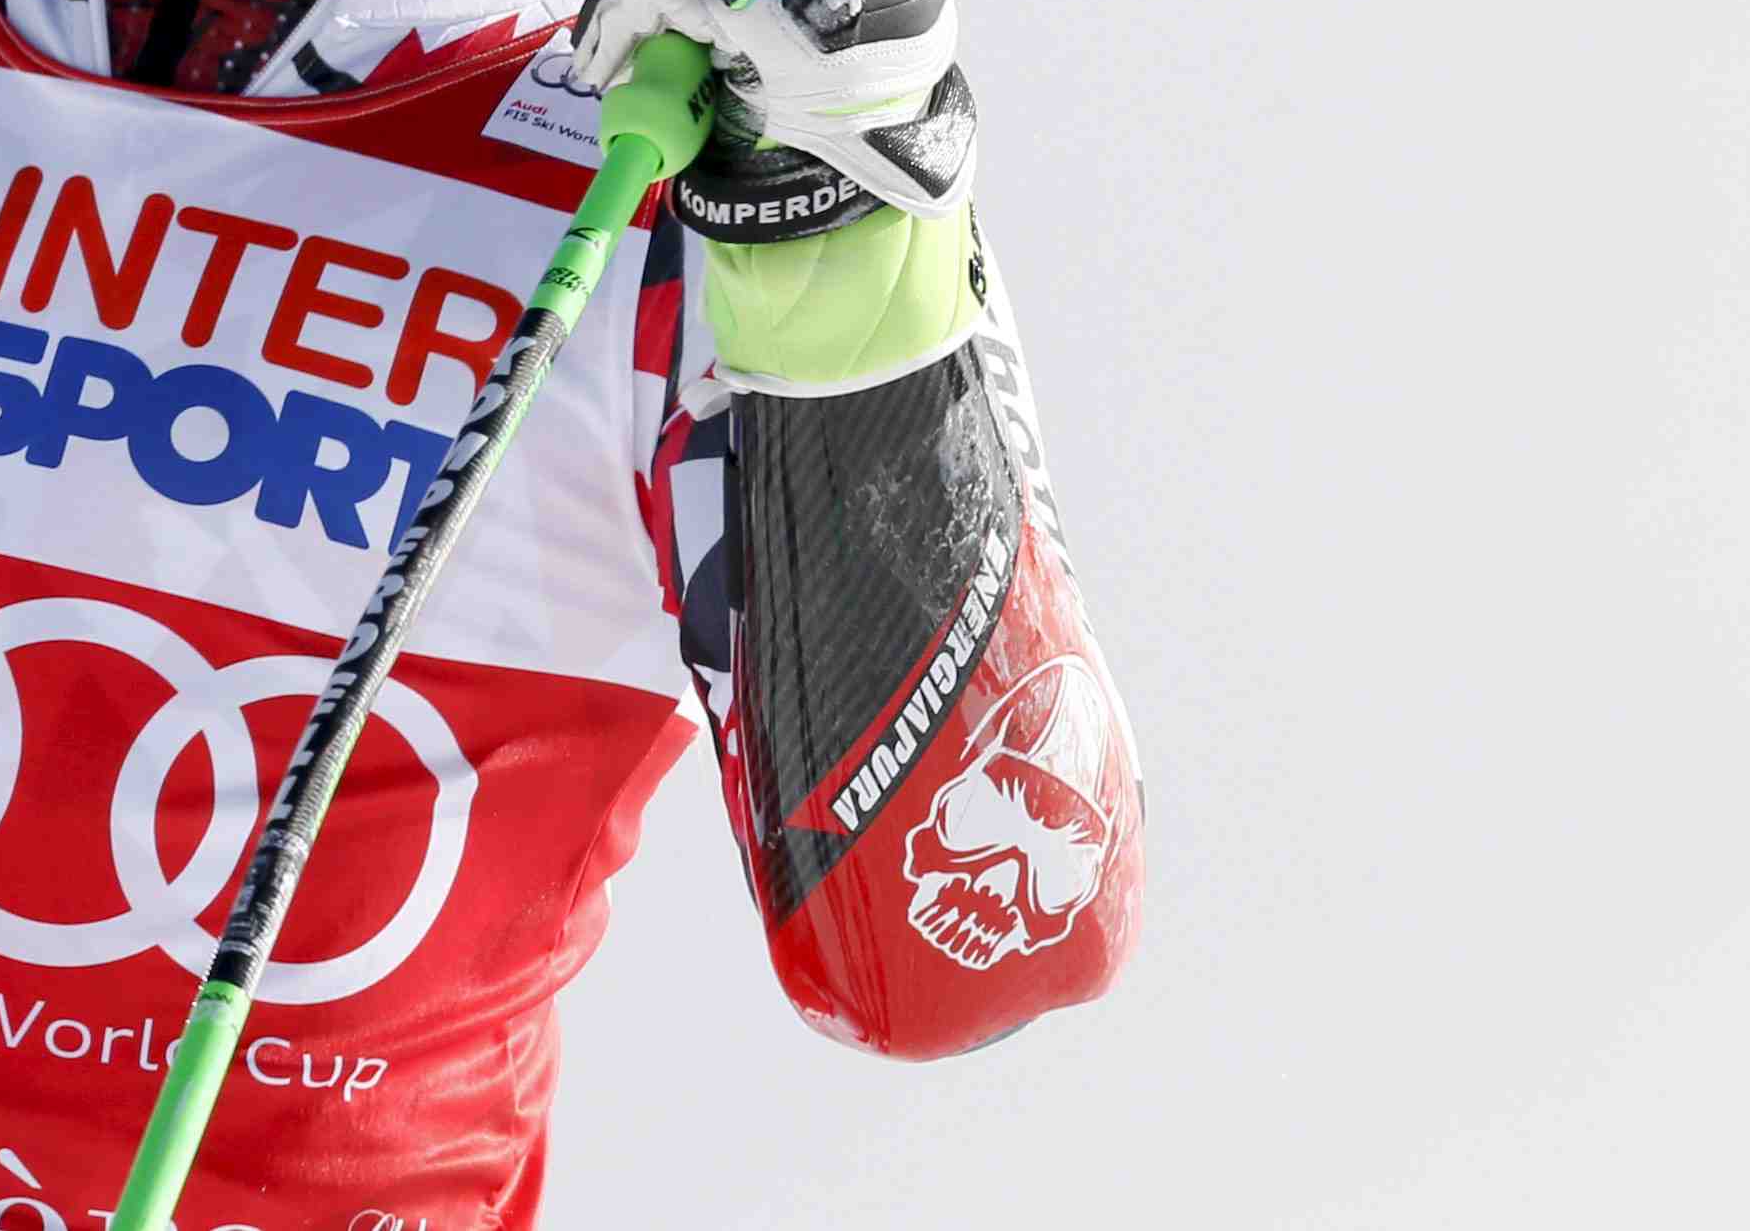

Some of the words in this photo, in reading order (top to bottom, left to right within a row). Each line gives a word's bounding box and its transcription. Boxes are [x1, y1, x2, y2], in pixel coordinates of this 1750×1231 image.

[503, 108, 529, 125] FIS
[531, 113, 555, 132] Ski
[510, 98, 549, 116] Audi
[679, 176, 873, 225] KOMPERDE
[831, 527, 1010, 832] ENERGIAPURA
[244, 1036, 390, 1103] Cup
